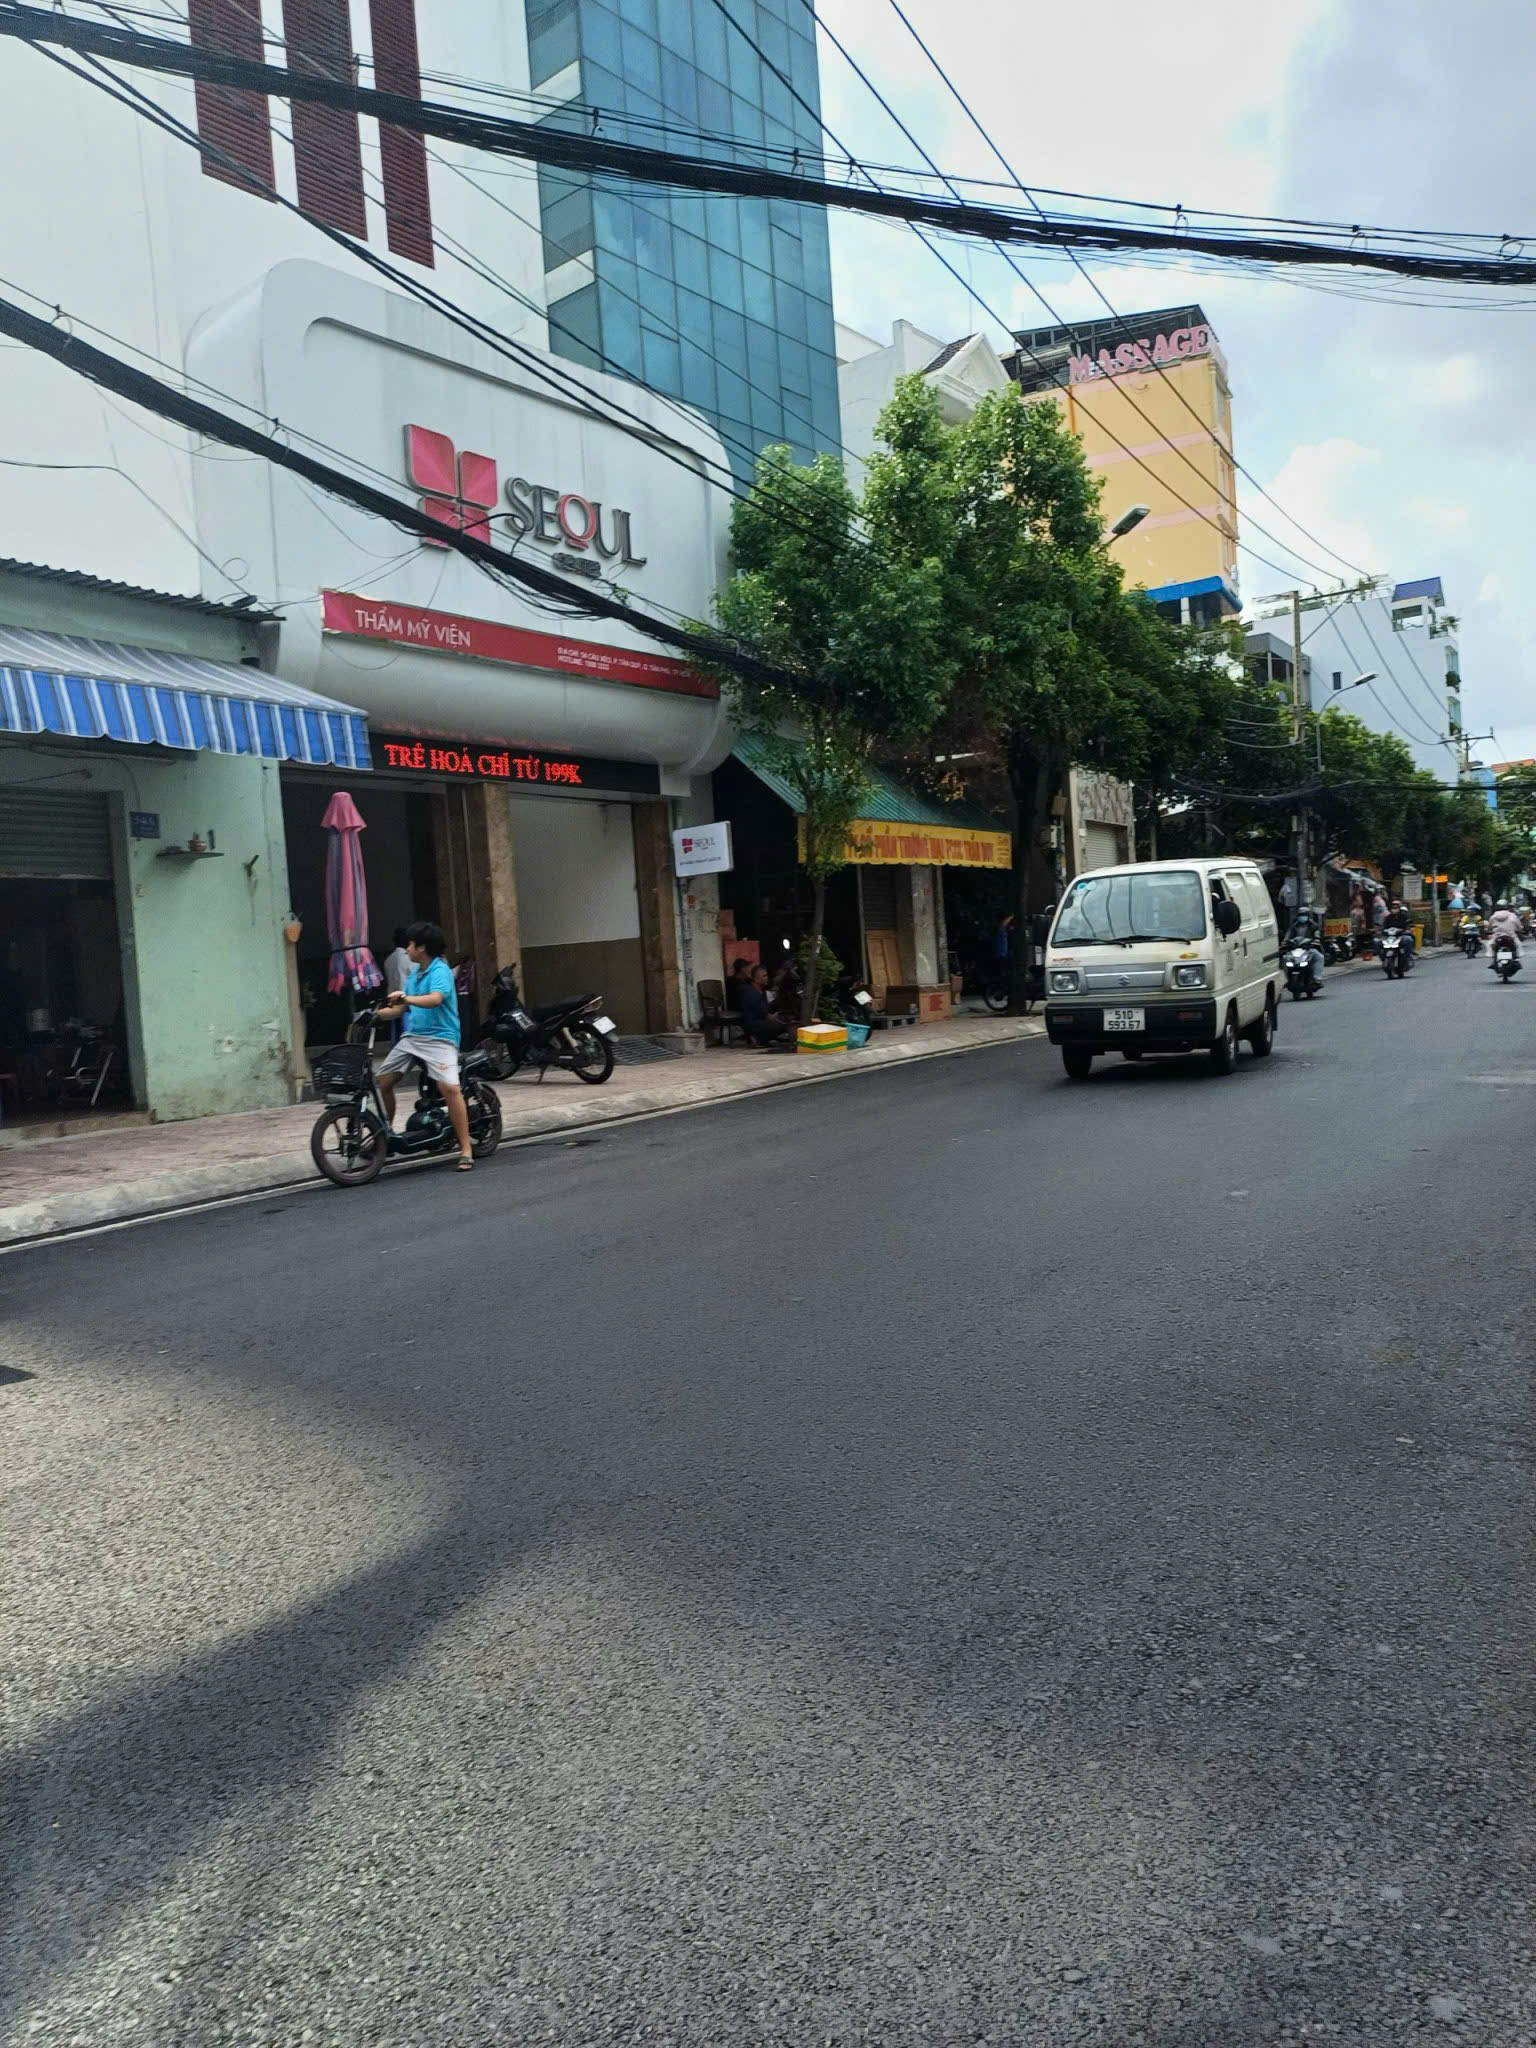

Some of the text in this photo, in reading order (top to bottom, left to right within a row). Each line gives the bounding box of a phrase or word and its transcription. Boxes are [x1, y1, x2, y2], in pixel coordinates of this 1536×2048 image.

[1067, 324, 1210, 384] MASSAGE
[504, 477, 647, 566] SEOUL
[355, 606, 471, 648] THẨM MỸ VIỆN
